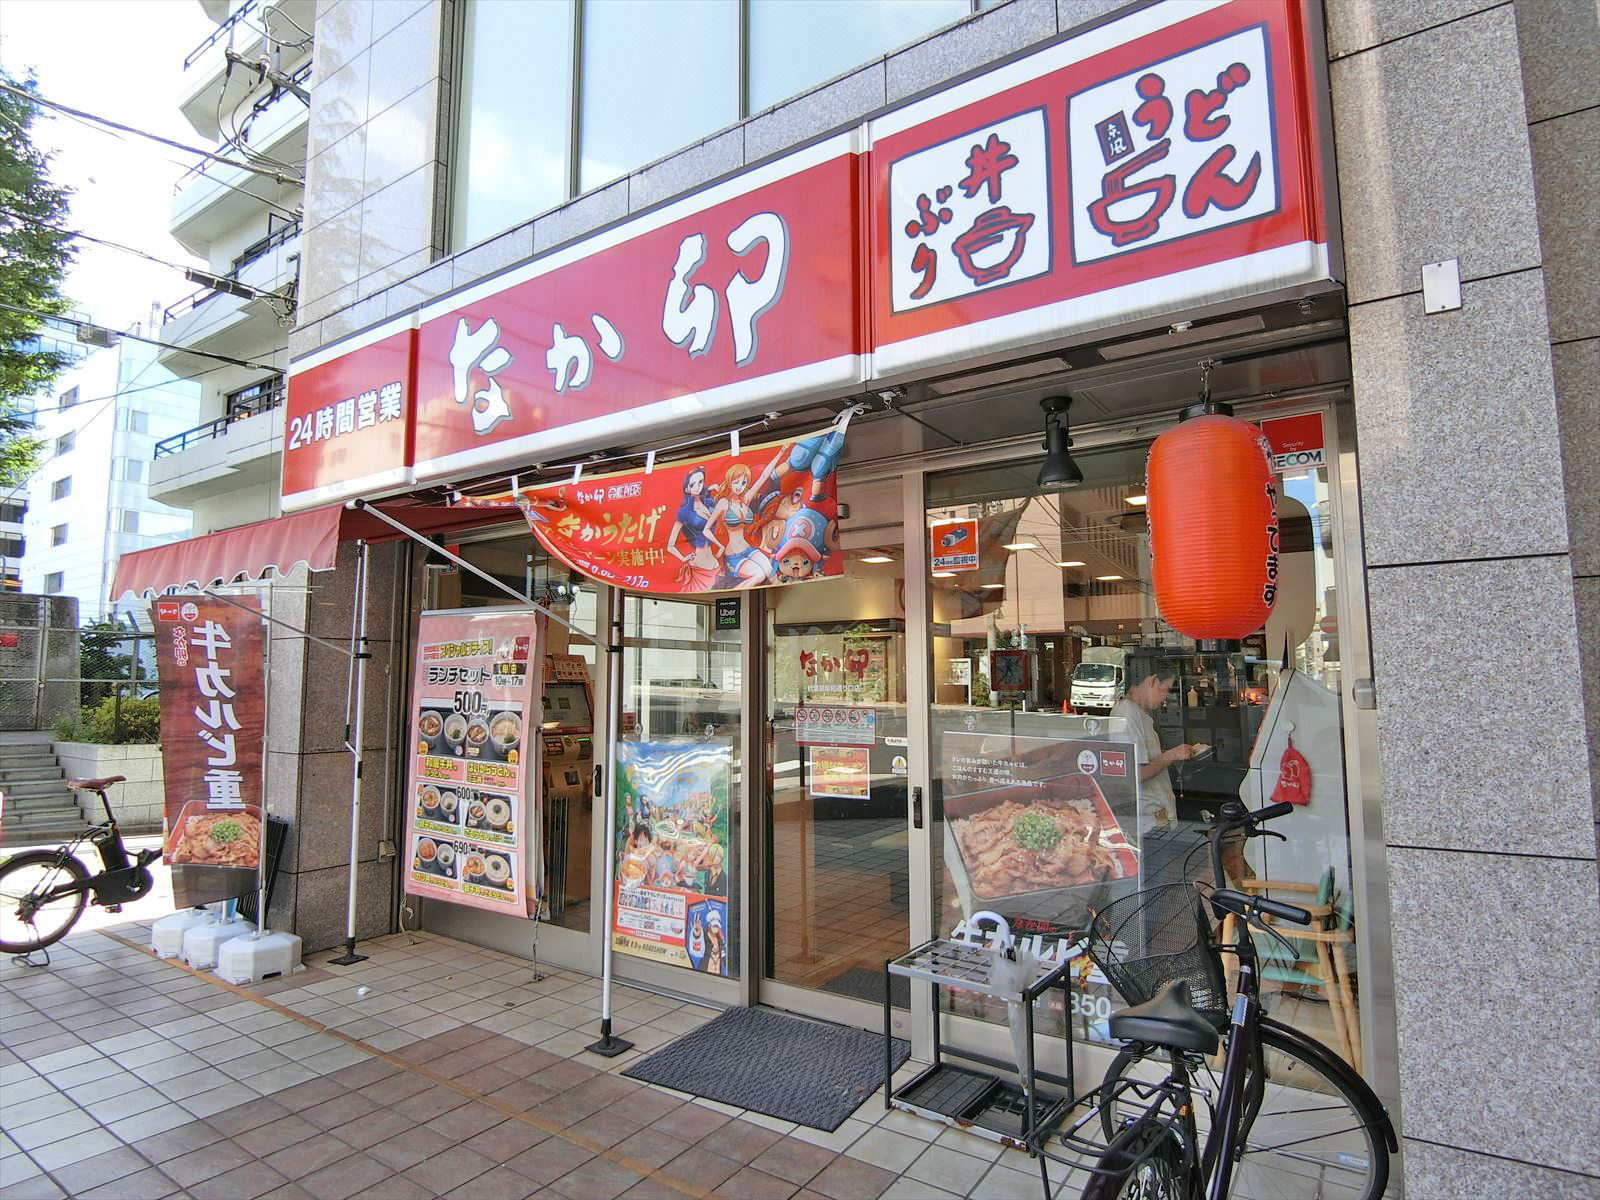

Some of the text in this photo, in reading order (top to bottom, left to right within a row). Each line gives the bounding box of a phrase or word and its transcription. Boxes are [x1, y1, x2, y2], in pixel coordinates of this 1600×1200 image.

[1133, 62, 1261, 219] うどん
[449, 211, 790, 436] なか卯
[288, 381, 402, 451] 24時間営業
[576, 488, 605, 504] なか卯
[720, 609, 736, 617] Uber
[720, 616, 737, 625] Eats
[800, 648, 870, 679] なか卯
[428, 666, 492, 686] ランチセット
[1102, 758, 1124, 769] なか卯
